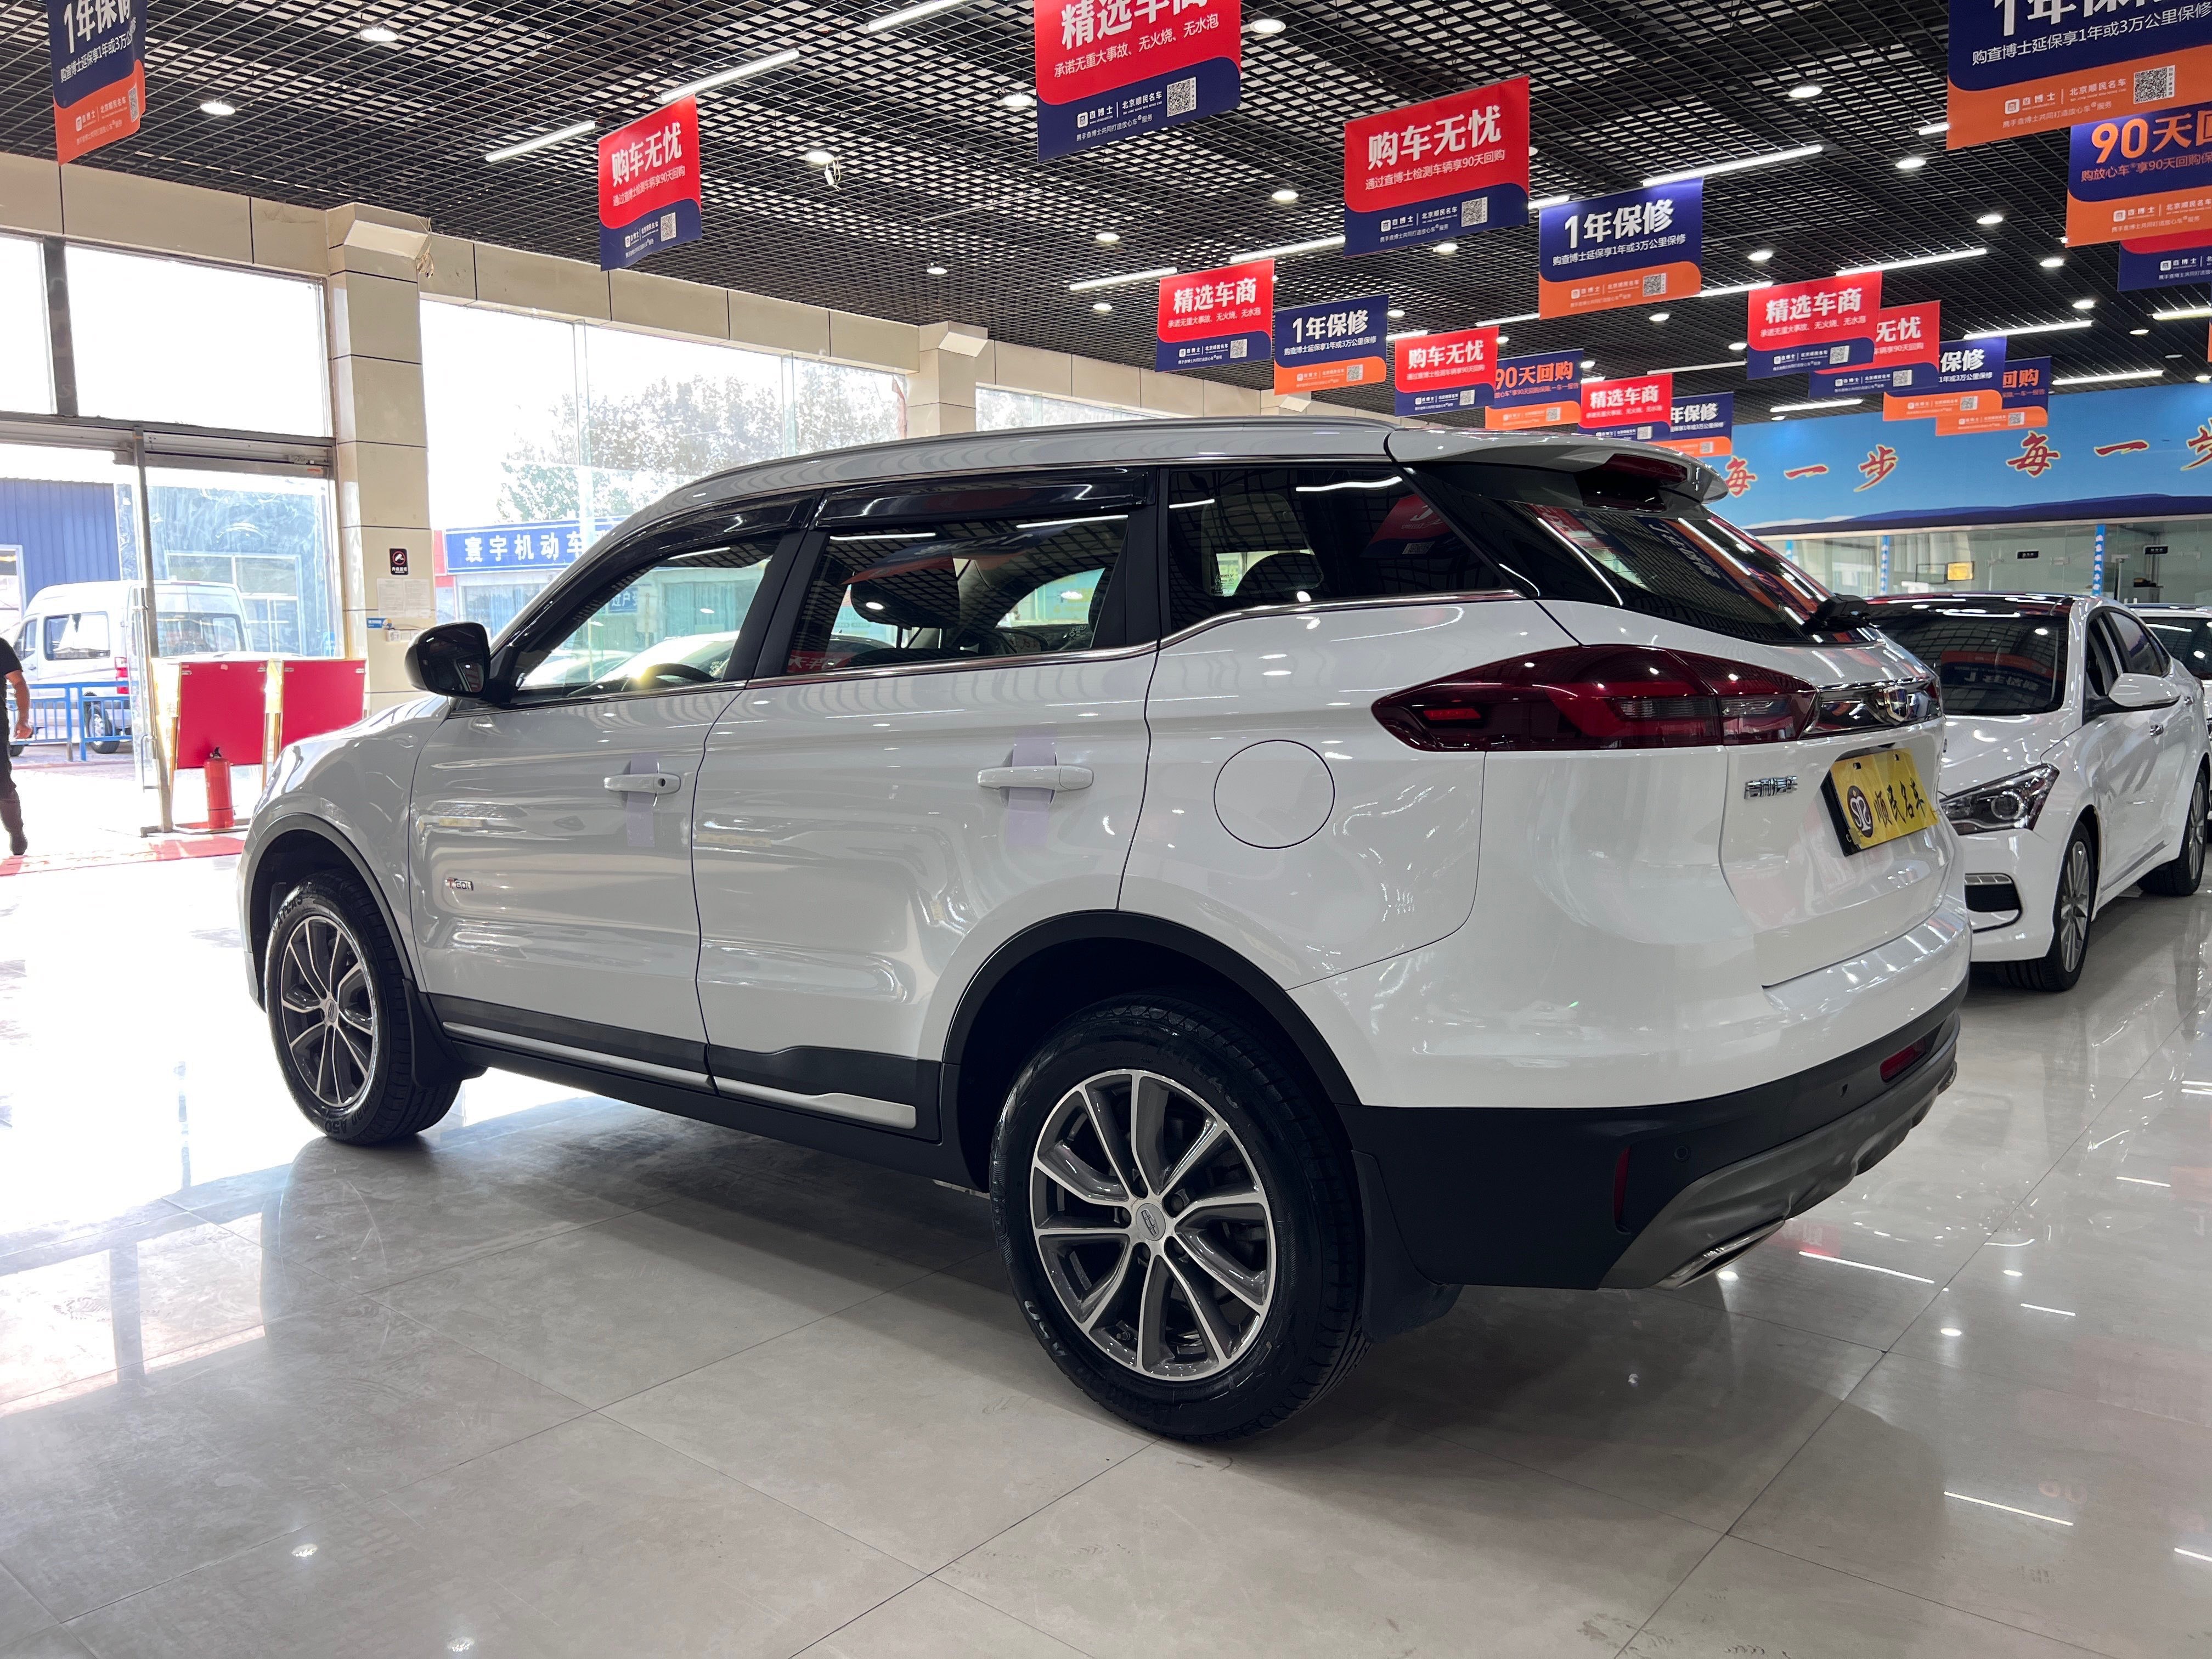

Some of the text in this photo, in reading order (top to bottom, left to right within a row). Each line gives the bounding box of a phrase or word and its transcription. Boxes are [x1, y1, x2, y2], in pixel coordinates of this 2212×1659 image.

[1972, 2, 2211, 65] 购查博士延保享1年或3万公里保修
[1122, 91, 1163, 109] 北京顺民名车
[2069, 78, 2126, 97] 北京顺民名车
[611, 121, 682, 188] 购车无忧
[1368, 105, 1502, 171] 购车无忧
[1365, 149, 1505, 190] 通过查博士检测车辆享90天回购
[1565, 199, 1674, 249] 1年保修
[1173, 277, 1257, 314] 精选车商
[1765, 287, 1863, 324] 精选车商
[1293, 309, 1369, 343] 1年保修
[1408, 339, 1484, 369] 购车无忧
[1940, 348, 1985, 373] 保修
[1496, 360, 1573, 390] 90天回购
[1590, 385, 1659, 409] 精选车商
